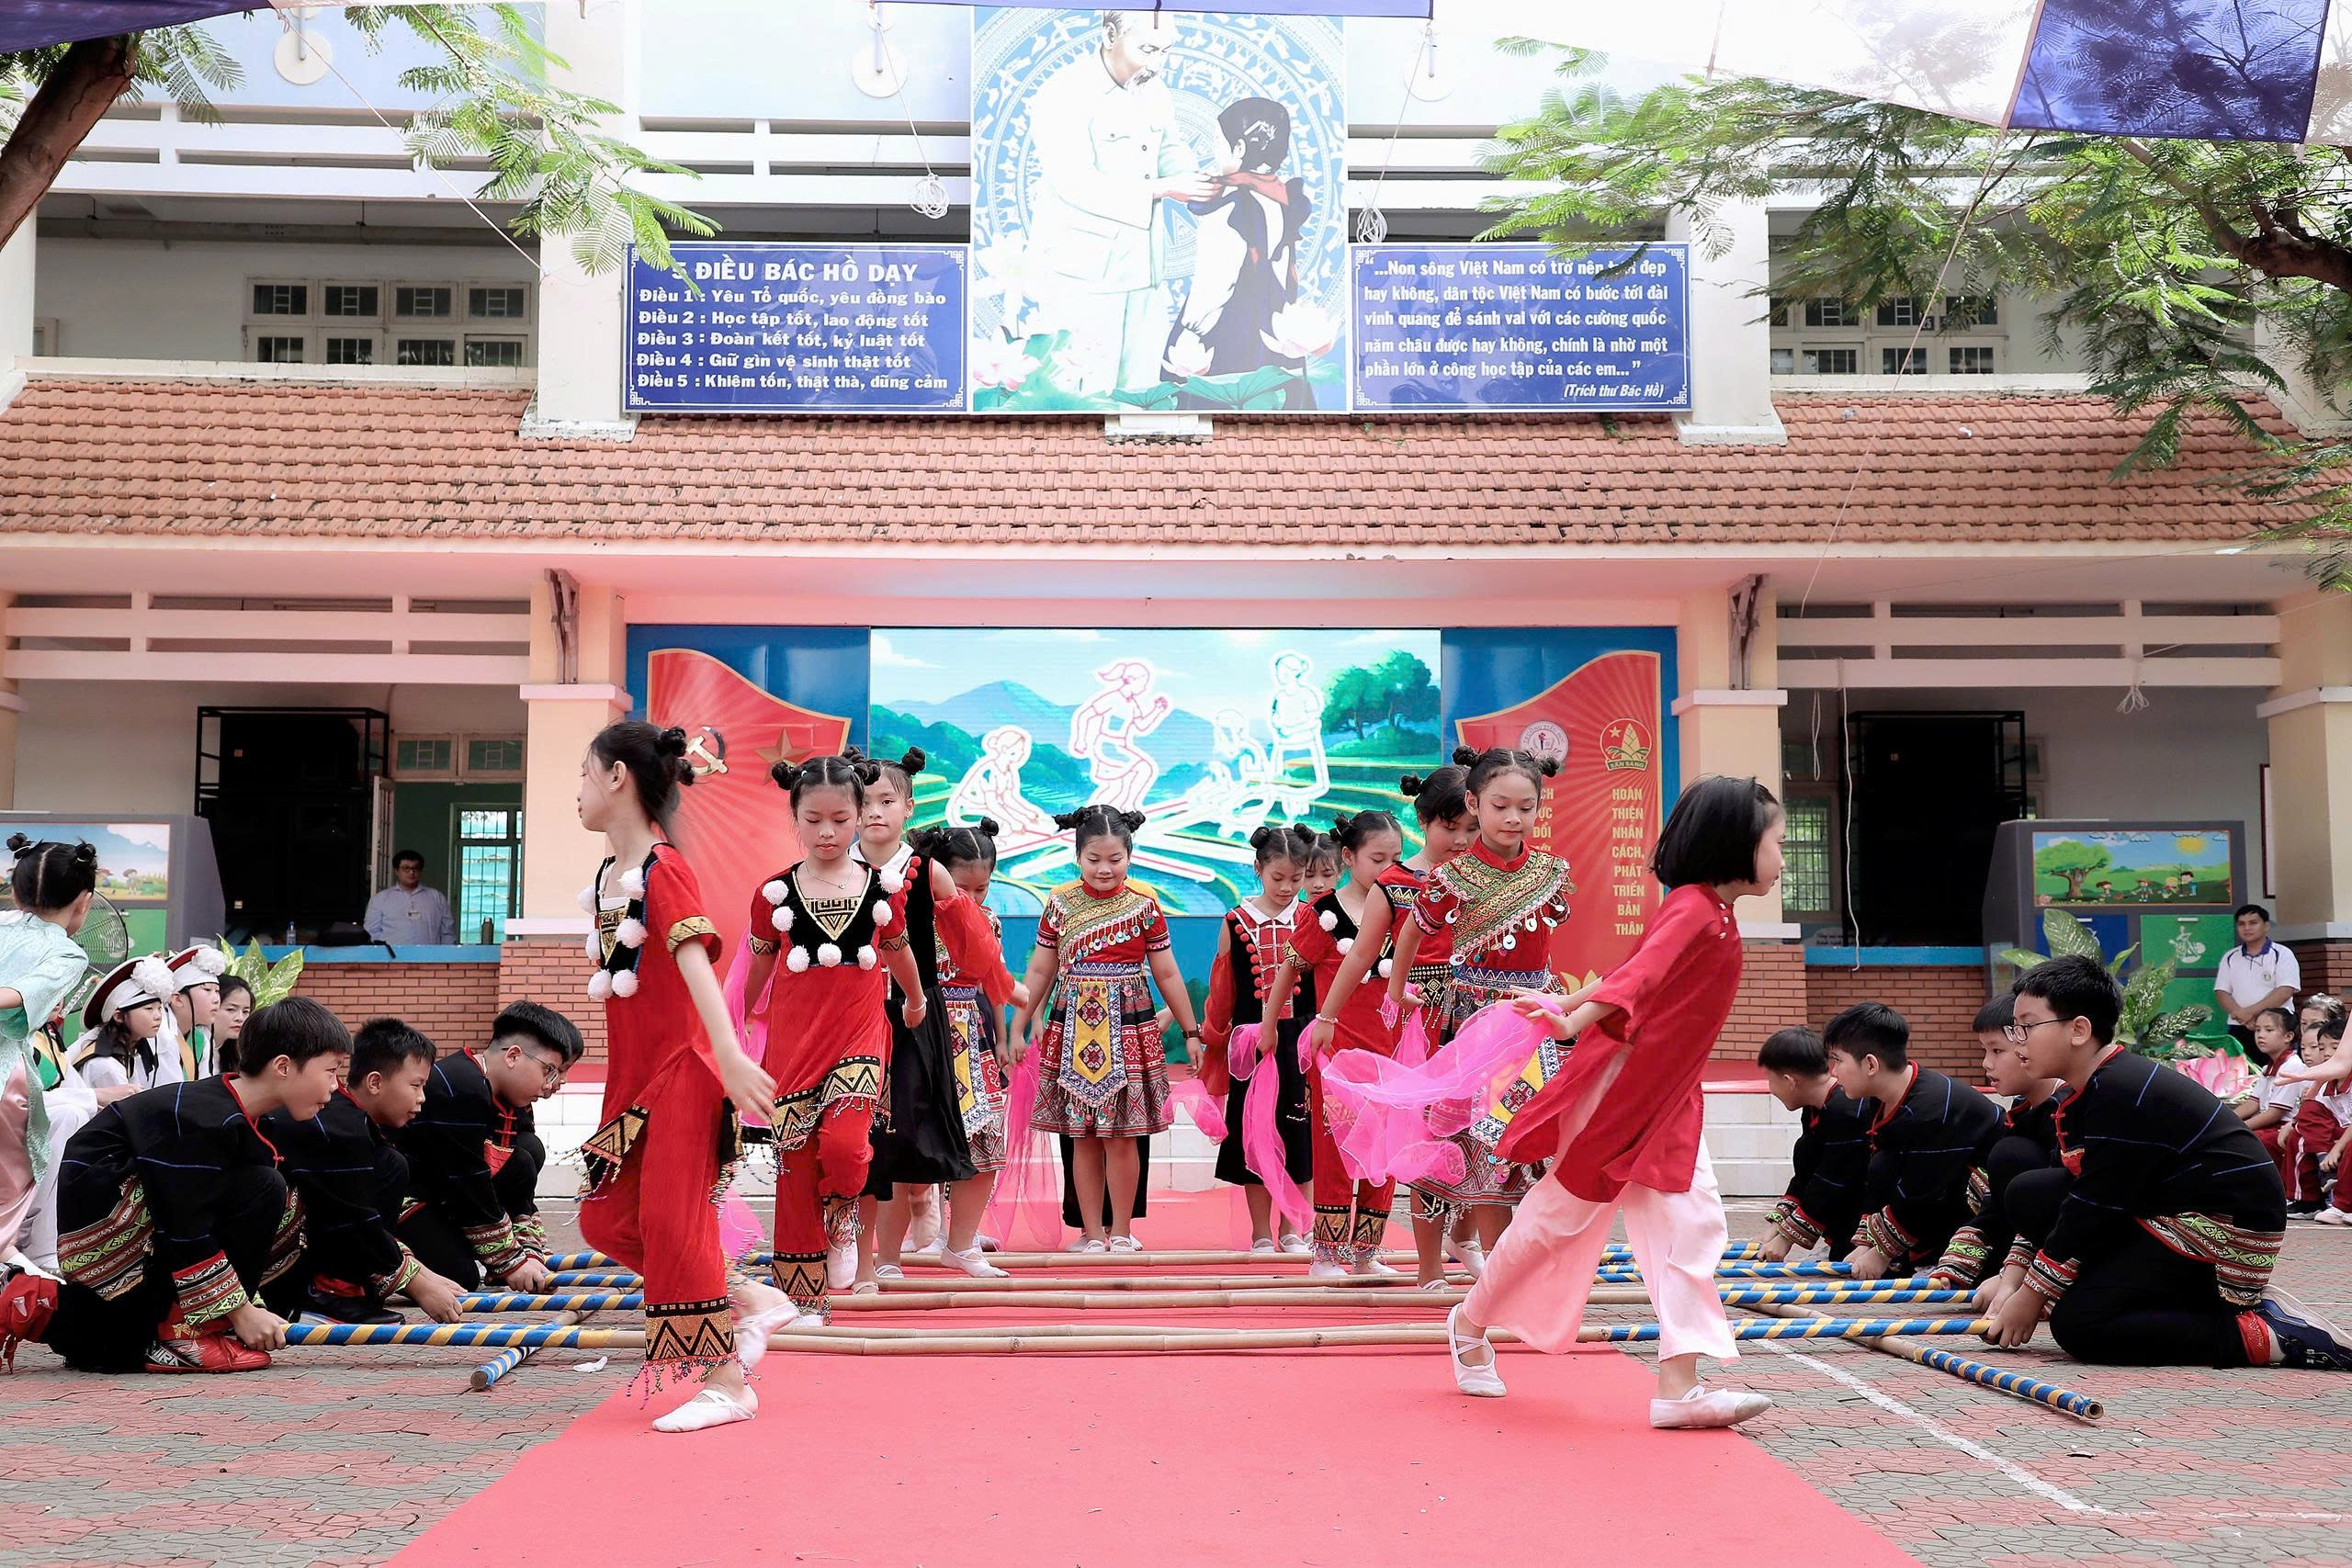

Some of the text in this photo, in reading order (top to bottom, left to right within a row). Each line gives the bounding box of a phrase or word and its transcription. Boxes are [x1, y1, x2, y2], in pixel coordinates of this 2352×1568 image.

[672, 254, 919, 287] 5 ĐIỀU BÁC HỒ DẠY
[1419, 262, 1455, 278] sông
[1459, 260, 1488, 279] Việt
[1492, 260, 1525, 275] Nam
[1529, 260, 1546, 275] có
[1577, 260, 1604, 275] nên
[1640, 259, 1667, 277] đẹp
[639, 287, 678, 302] Điều
[684, 288, 694, 302] 1
[711, 289, 744, 303] Yêu
[751, 285, 772, 303] Tổ
[778, 288, 825, 306] quốc,
[830, 291, 861, 306] yêu
[865, 288, 909, 307] đồng
[914, 291, 946, 305] bào
[1363, 284, 1668, 304] hay không, dân tộc Việt Nam có bước tới đài
[639, 308, 678, 324] Điều
[682, 310, 695, 324] 2
[712, 311, 746, 328] Học
[751, 312, 780, 329] tập
[786, 310, 819, 329] tốt,
[823, 313, 850, 326] lao
[854, 313, 898, 330] động
[902, 310, 929, 327] tốt
[1363, 306, 1667, 329] vinh quang để sánh vai với các cường quốc
[637, 329, 676, 345] Điều
[682, 333, 694, 345] 3
[710, 332, 754, 345] Đoàn
[763, 330, 790, 345] kết
[796, 331, 828, 349] tốt,
[833, 333, 854, 350] kỷ
[860, 333, 893, 350] luật
[899, 331, 925, 347] tốt
[1364, 336, 1668, 355] năm châu được hay không, chính là nhờ một
[636, 350, 676, 367] Điều
[680, 353, 693, 367] 4
[709, 353, 740, 367] Giữ
[743, 354, 771, 369] gìn
[776, 355, 797, 371] vệ
[802, 355, 839, 368] sinh
[843, 355, 880, 371] thật
[884, 352, 911, 368] tốt
[1364, 358, 1399, 378] phần
[1403, 361, 1425, 377] lớn
[1429, 360, 1440, 377] ở
[1442, 362, 1477, 379] công
[1481, 361, 1507, 379] học
[1510, 361, 1534, 379] tập
[1537, 358, 1563, 376] của
[1566, 360, 1591, 376] các
[638, 370, 673, 388] Điều
[677, 374, 688, 388] 5
[705, 374, 755, 388] Khiêm
[759, 371, 792, 390] tốn,
[796, 375, 830, 392] thật
[833, 375, 865, 390] thà,
[870, 374, 910, 390] dũng
[914, 374, 947, 389] cảm
[1564, 382, 1664, 398] (Trích thư Bác Hồ)
[1611, 786, 1644, 801] HOÀN
[1611, 806, 1645, 822] THIỆN
[1611, 825, 1644, 840] NHÂN
[1611, 843, 1645, 860] CÁCH,
[1613, 863, 1644, 878] PHÁT
[1612, 880, 1646, 897] TRIỂN
[1617, 899, 1641, 917] BẢN
[1614, 920, 1645, 936] THÂN
